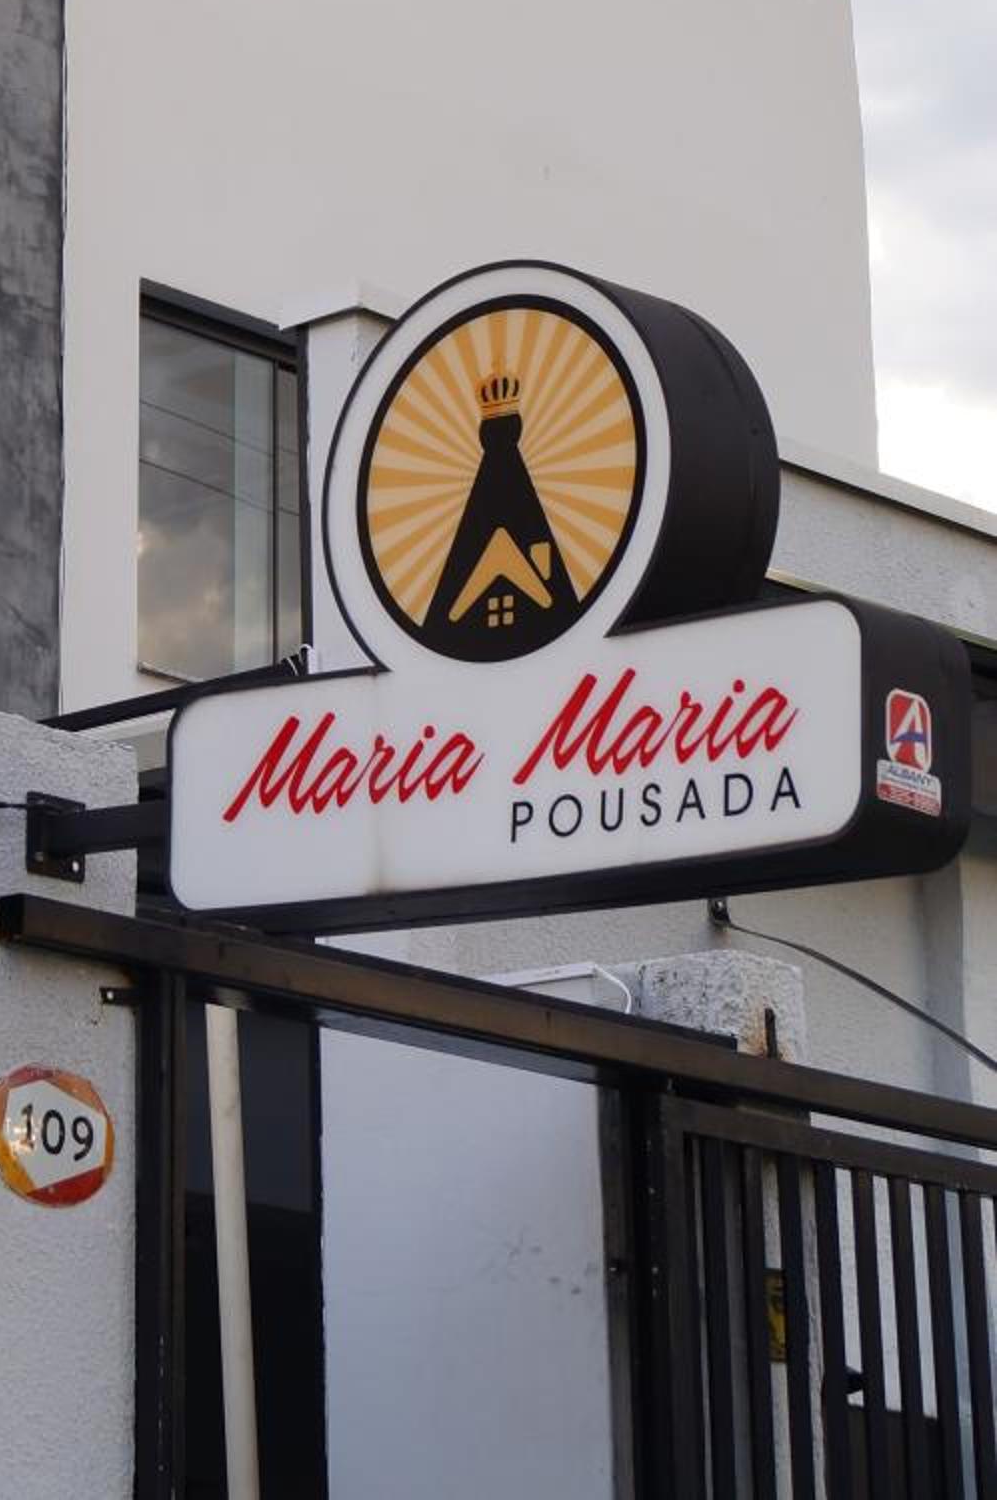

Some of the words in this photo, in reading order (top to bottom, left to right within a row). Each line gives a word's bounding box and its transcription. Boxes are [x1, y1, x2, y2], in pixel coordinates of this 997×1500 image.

[223, 712, 485, 822] Maria
[512, 667, 799, 785] Maria
[510, 766, 801, 843] POUSADA
[21, 1103, 94, 1161] 109
